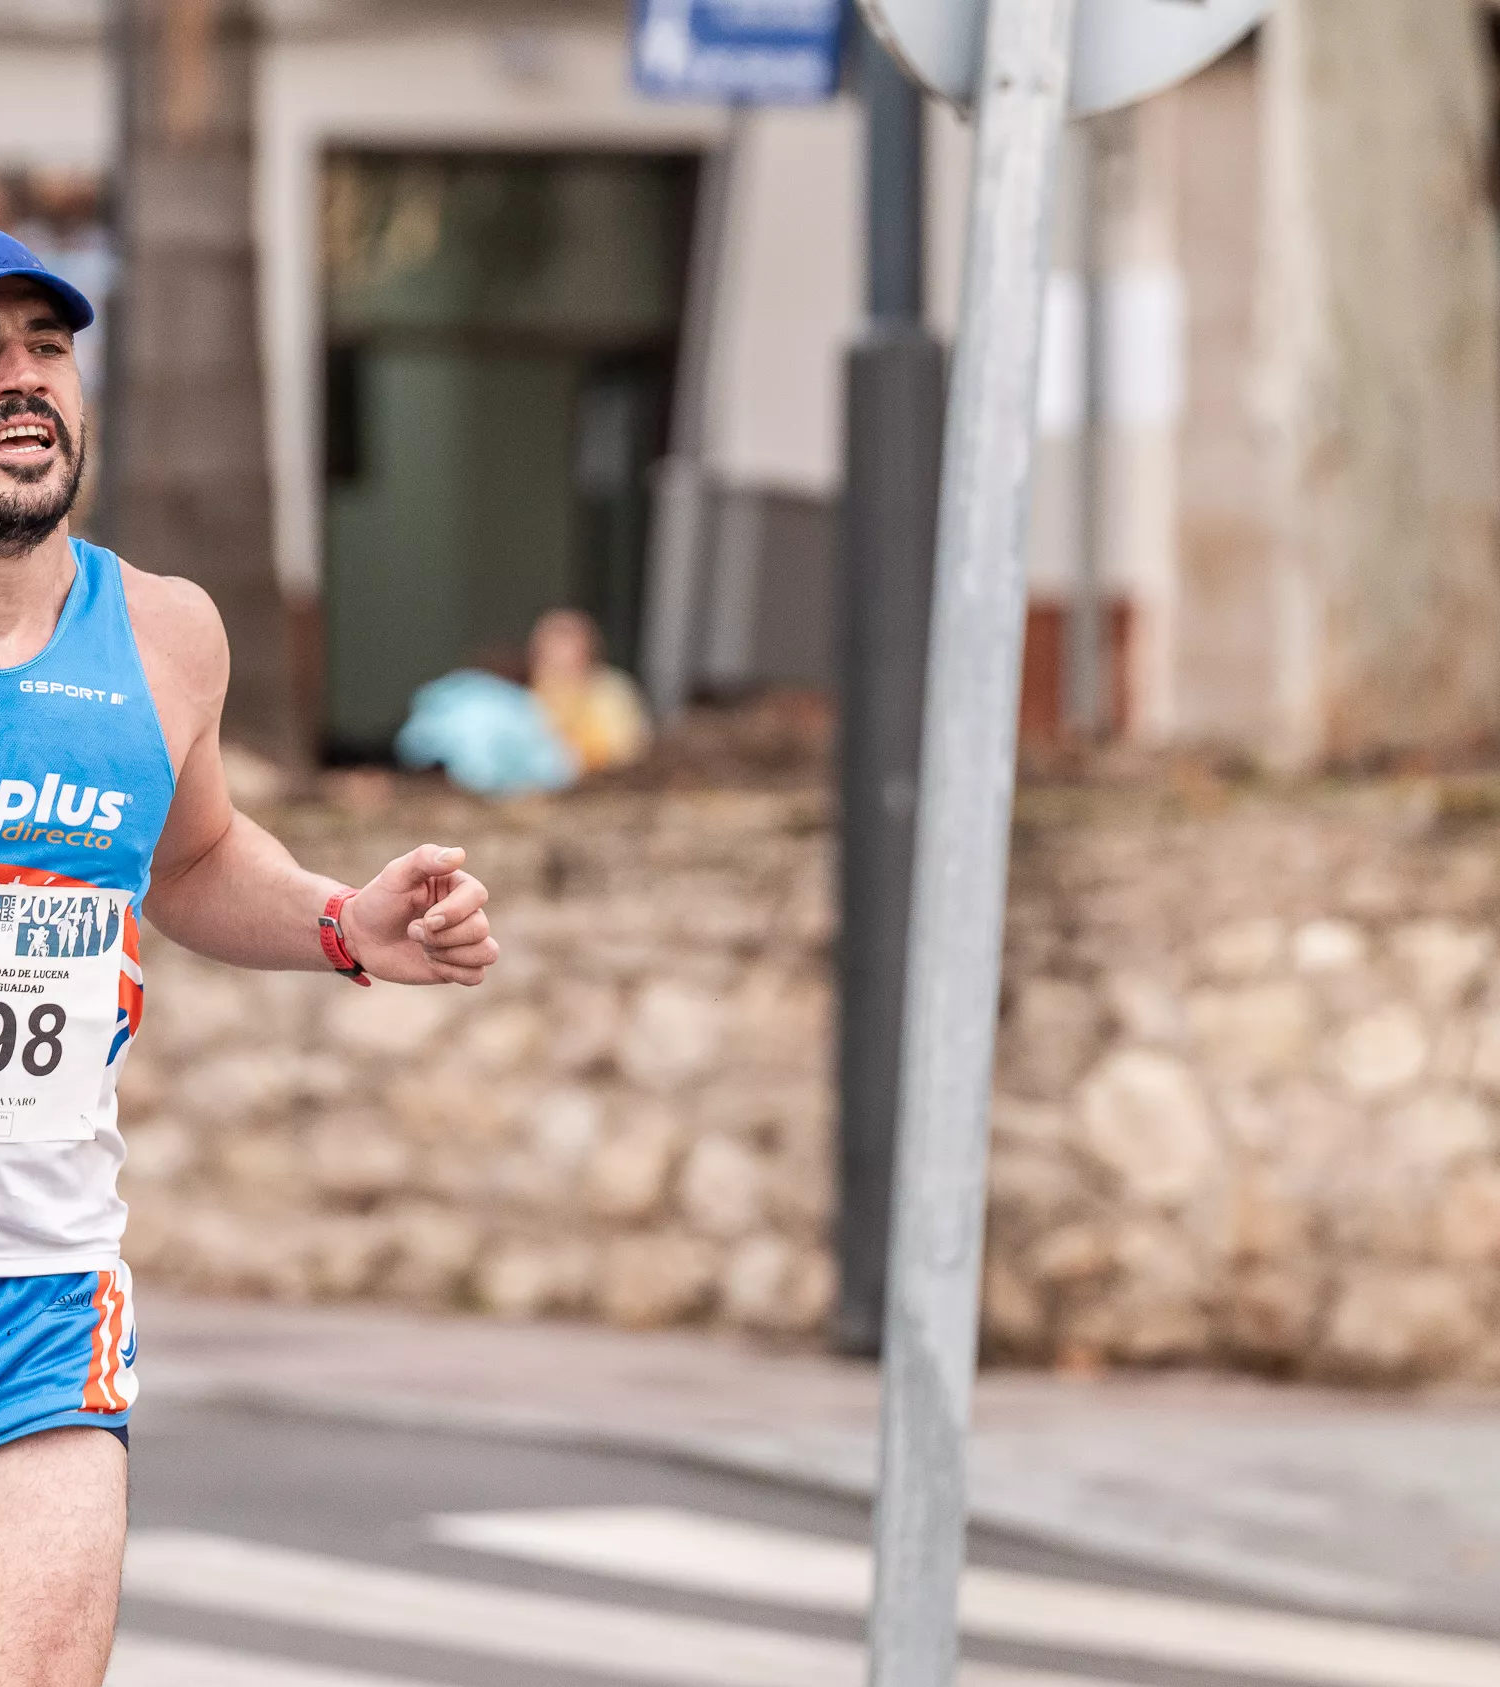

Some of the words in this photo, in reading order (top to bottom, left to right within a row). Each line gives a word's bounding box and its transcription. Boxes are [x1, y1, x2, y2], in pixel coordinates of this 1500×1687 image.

[19, 680, 106, 702] GSPORT
[1, 821, 113, 850] directo
[2, 895, 17, 908] DE
[19, 896, 83, 926] 2024
[17, 969, 31, 979] DE
[32, 969, 70, 980] LUCENA
[8, 1097, 37, 1107] VARO
